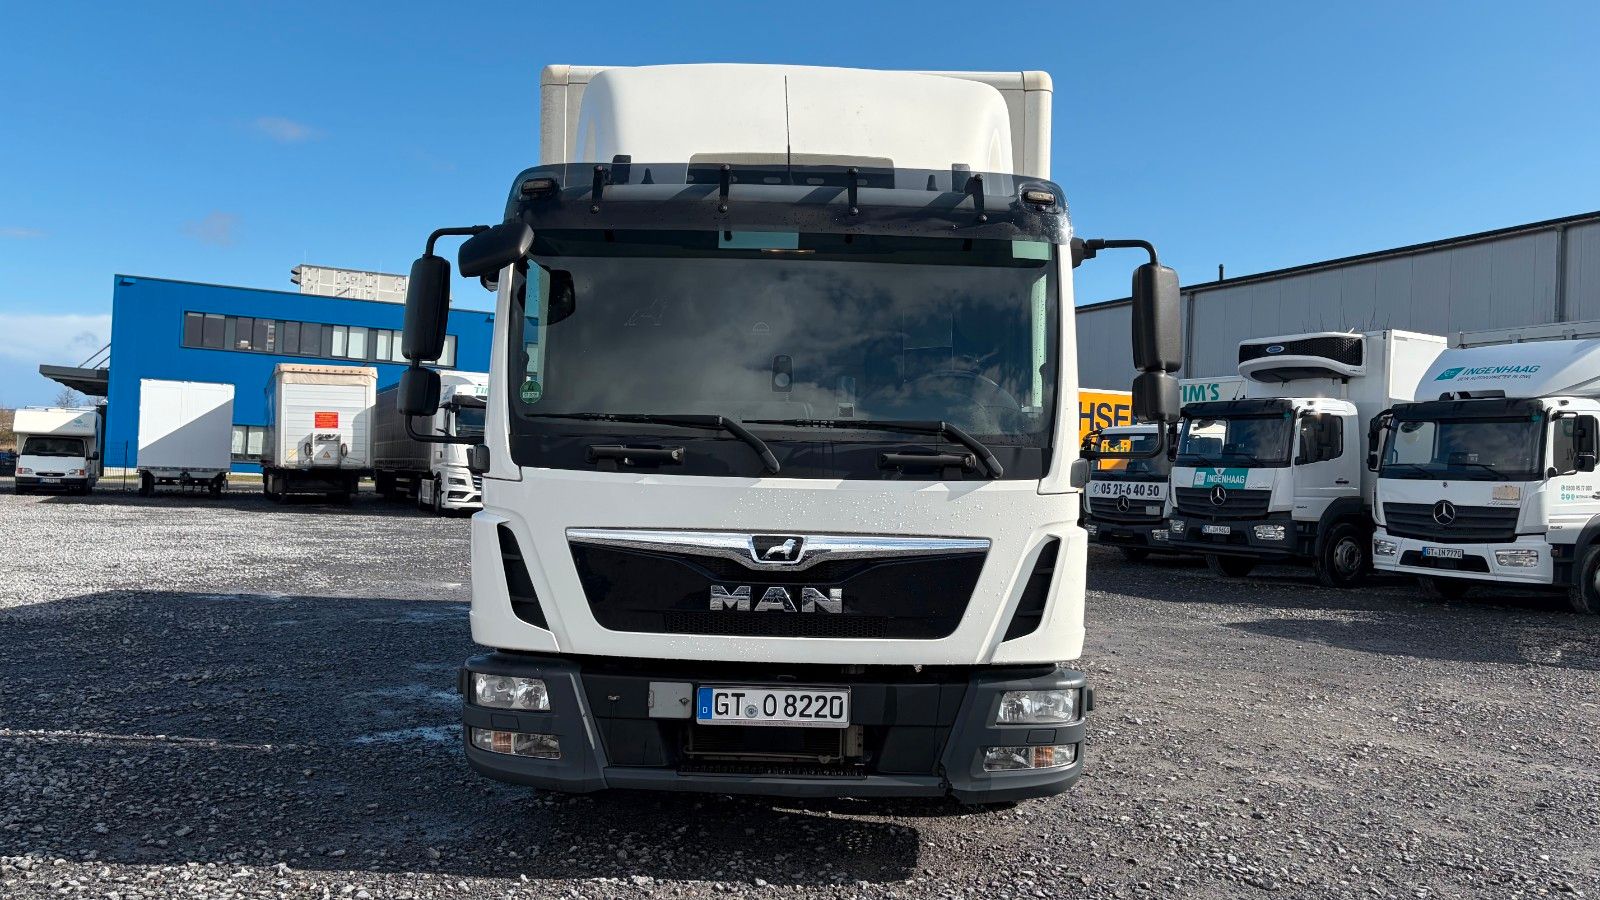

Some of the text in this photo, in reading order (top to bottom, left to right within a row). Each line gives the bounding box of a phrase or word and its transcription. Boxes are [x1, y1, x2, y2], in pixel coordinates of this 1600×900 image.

[1462, 365, 1540, 376] INGENHAAG
[474, 386, 488, 394] TI
[1179, 383, 1219, 402] IM'S
[1206, 474, 1245, 484] INGENHAAG
[1101, 483, 1111, 495] 05
[1133, 484, 1145, 496] 40
[1147, 485, 1160, 497] 50
[709, 585, 843, 613] MAN
[715, 692, 746, 716] GT
[784, 694, 844, 719] 8220
